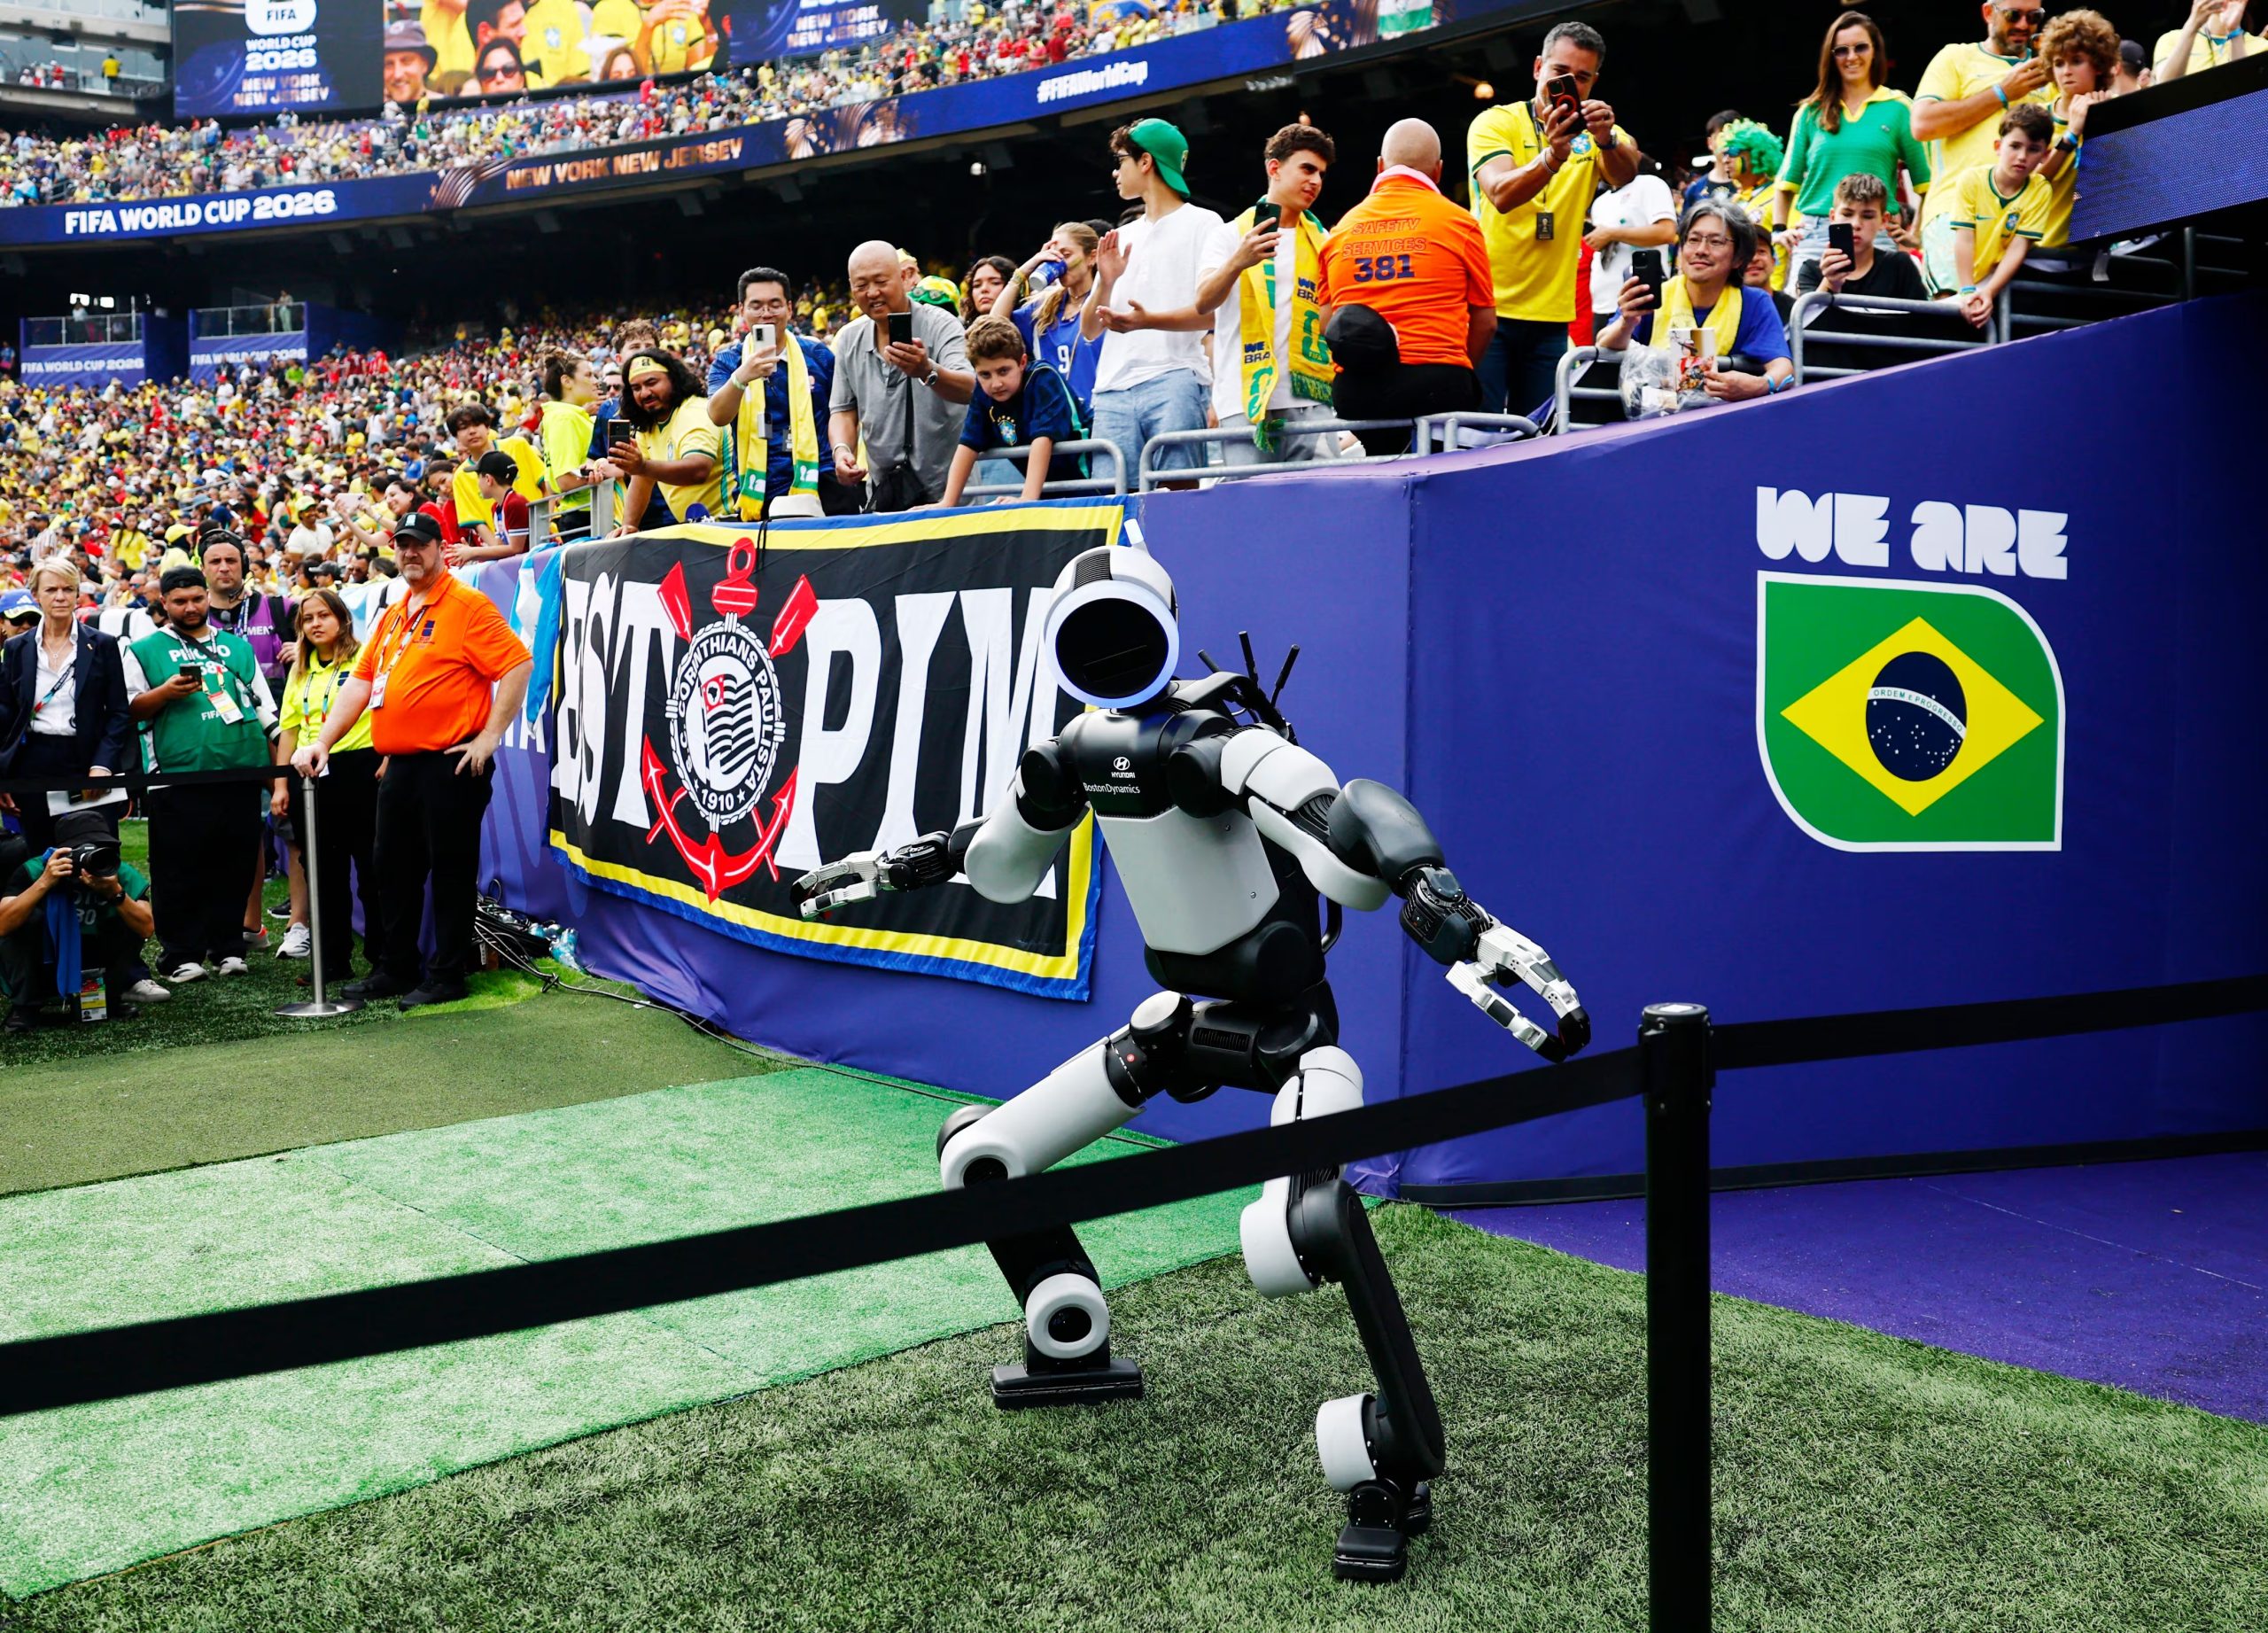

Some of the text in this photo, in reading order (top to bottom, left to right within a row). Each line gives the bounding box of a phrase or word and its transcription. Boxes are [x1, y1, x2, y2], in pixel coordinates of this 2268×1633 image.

[267, 9, 297, 21] FIFA
[796, 12, 832, 32] NEW
[836, 4, 879, 24] YORK
[245, 35, 317, 51] WORLD CUP
[787, 19, 889, 48] NEW JERSEY
[245, 48, 317, 72] 2026
[242, 74, 321, 92] NEW YORK
[1037, 60, 1148, 104] #FIFAWorldCup
[233, 86, 330, 106] NEW JERSEY
[506, 137, 744, 191] NEW YORK NEW JERSEY
[64, 190, 336, 235] FIFA WORLD CUP 2026
[1352, 217, 1421, 235] SAFETY
[1342, 237, 1427, 257] SERVICES
[1353, 254, 1416, 283] 381
[20, 357, 144, 374] FIFA WORLD CUP 2026
[190, 354, 213, 366] FIFA
[1057, 345, 1070, 373] 9
[1756, 486, 2069, 580] WE ARE
[679, 634, 758, 718] CORINTHIANS
[744, 668, 774, 791] PAULISTA
[1874, 689, 1906, 698] ORDEM
[1915, 696, 1963, 732] PROGRESSO
[701, 789, 734, 812] 1910
